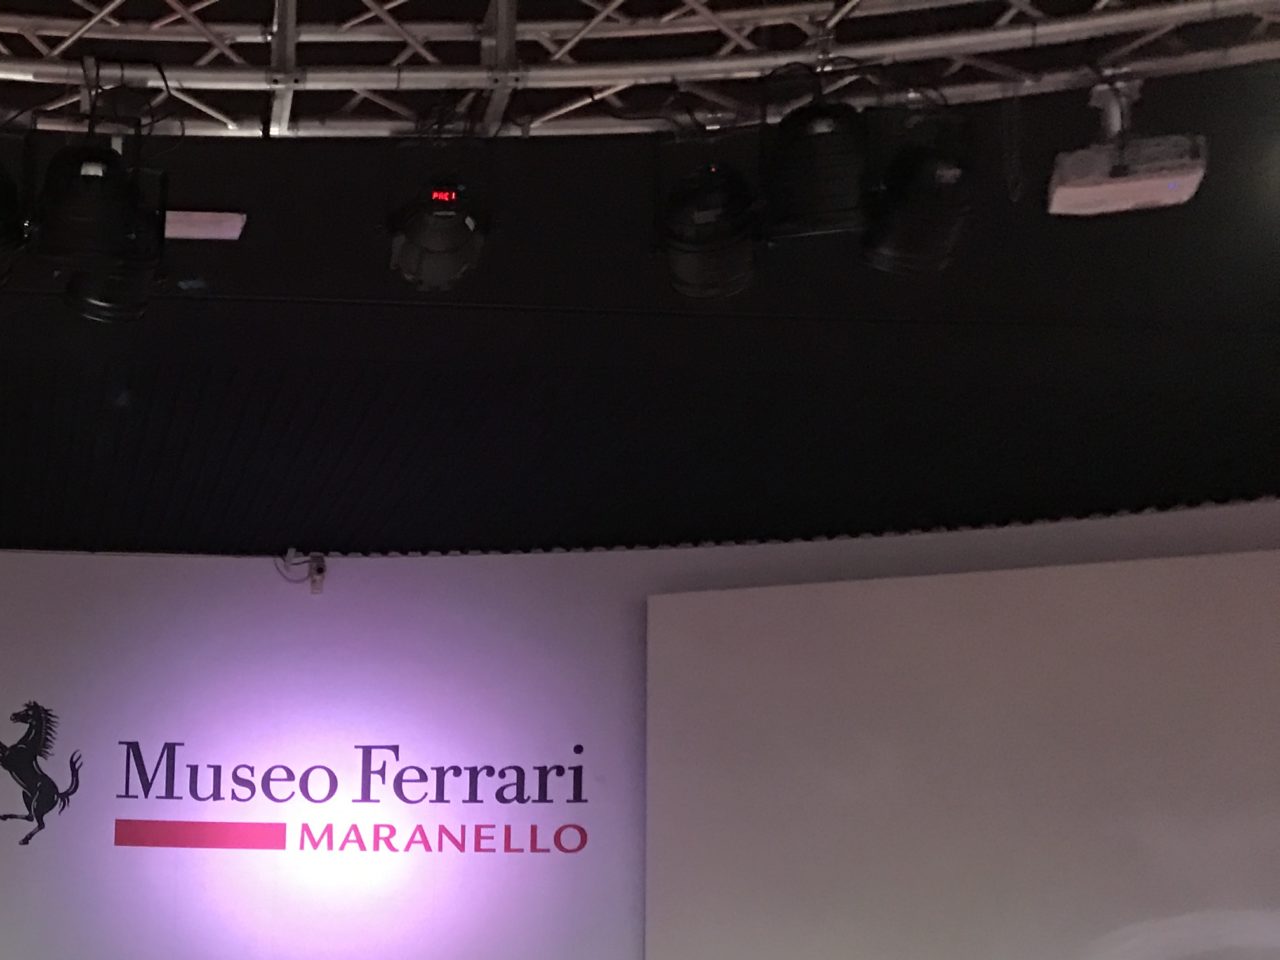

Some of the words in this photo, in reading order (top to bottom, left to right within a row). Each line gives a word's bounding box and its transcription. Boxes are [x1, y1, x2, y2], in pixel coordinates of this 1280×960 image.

[116, 741, 339, 802] Museo
[352, 744, 589, 804] Ferrari
[298, 822, 589, 854] MARANELLO
